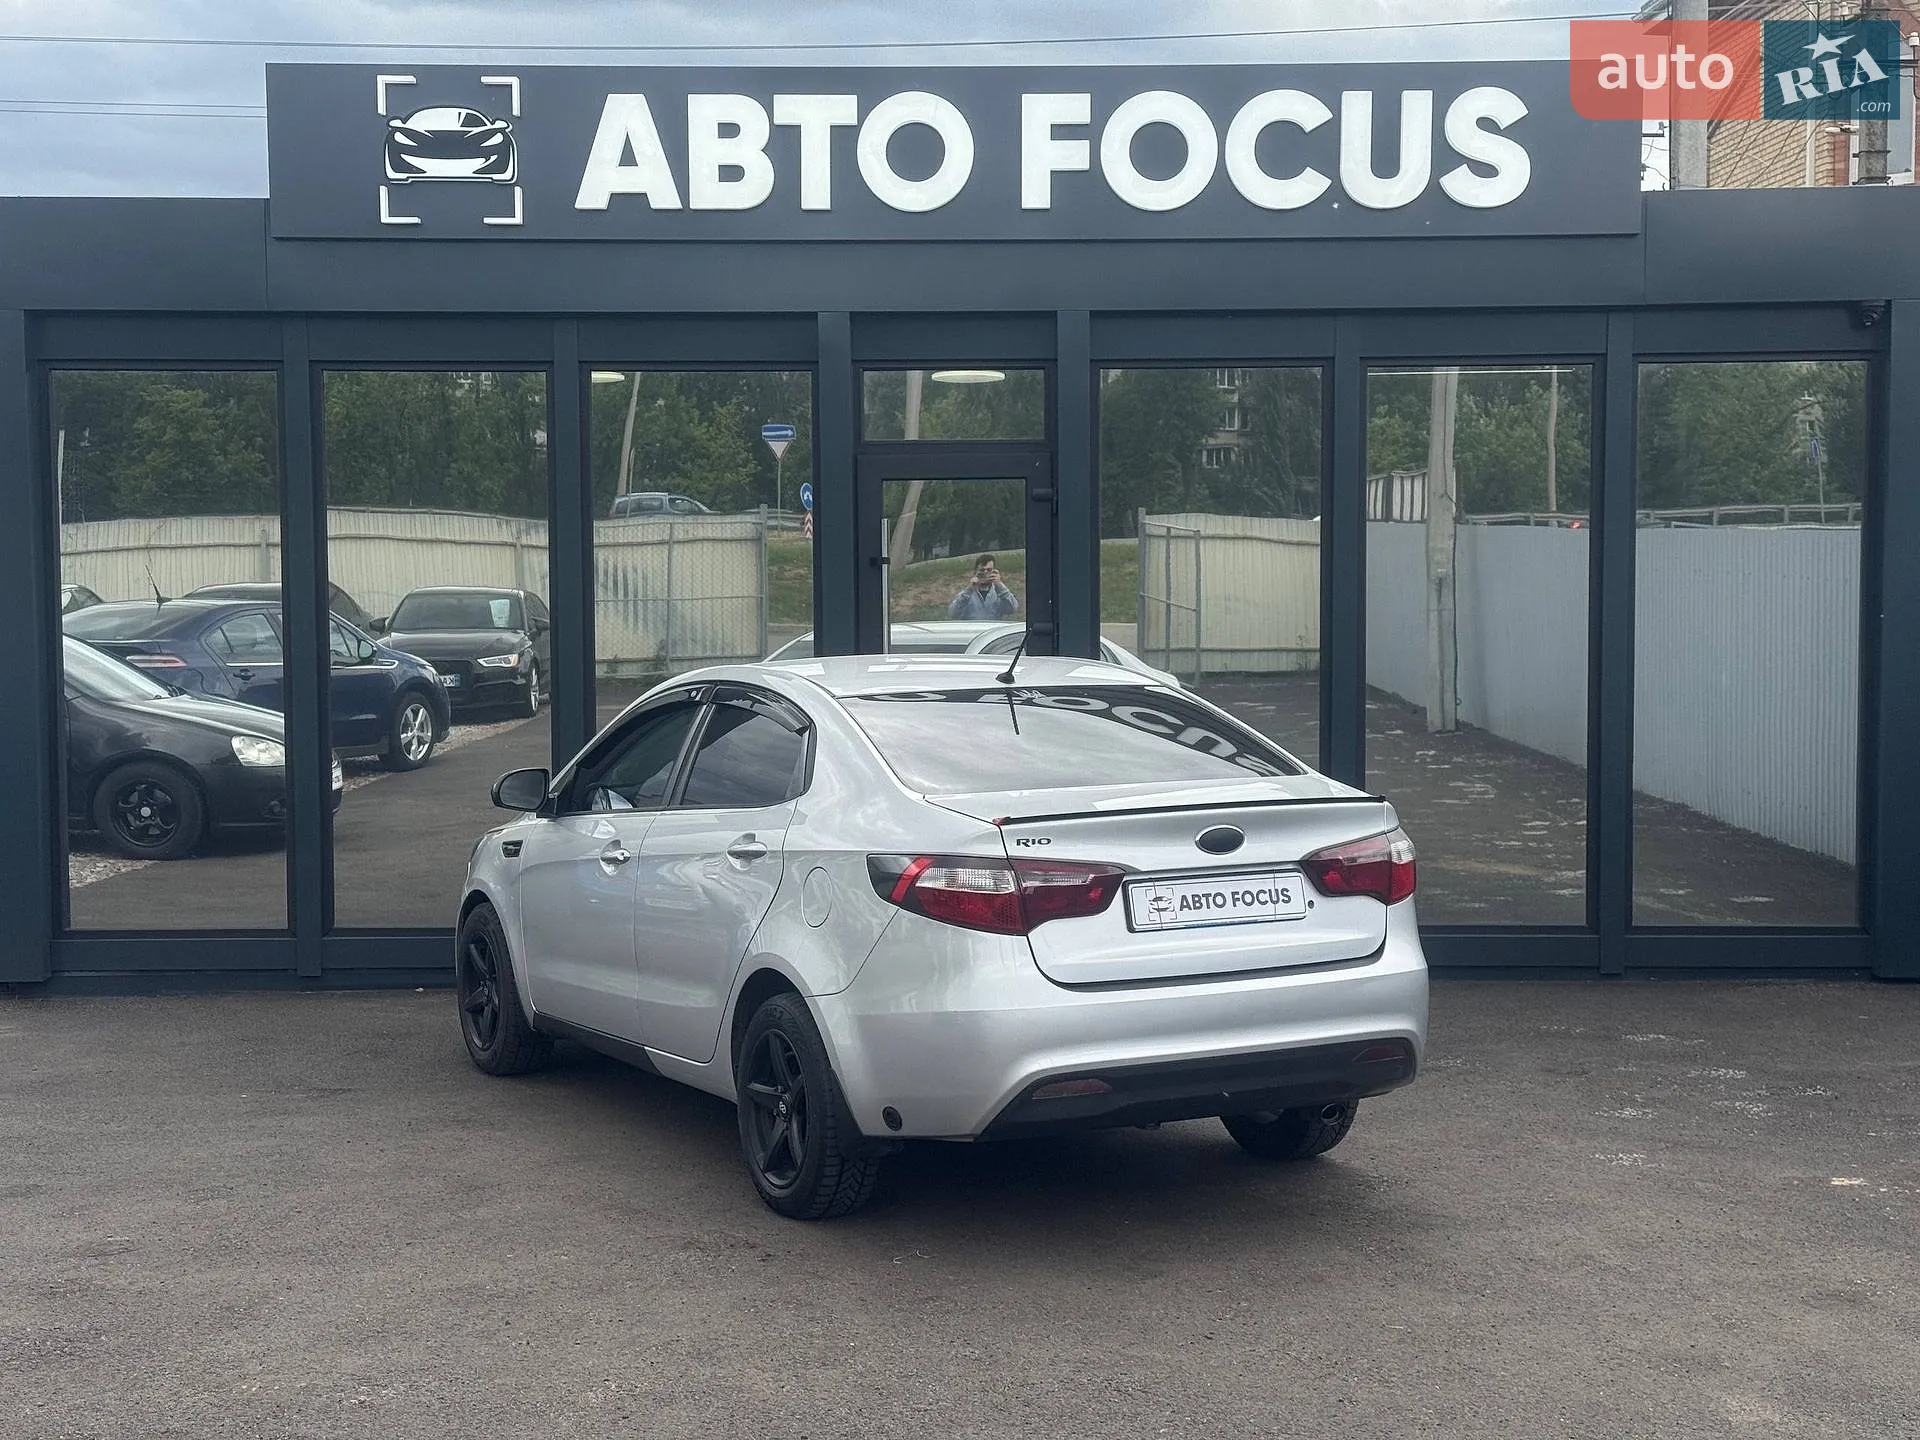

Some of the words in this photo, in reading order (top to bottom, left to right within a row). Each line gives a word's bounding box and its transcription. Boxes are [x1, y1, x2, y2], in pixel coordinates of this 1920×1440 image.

[574, 90, 975, 212] АВТО
[1021, 86, 1532, 212] FOCUS
[1016, 837, 1052, 848] RIO
[1179, 892, 1227, 912] АВТО
[1231, 887, 1292, 907] FOCUS
